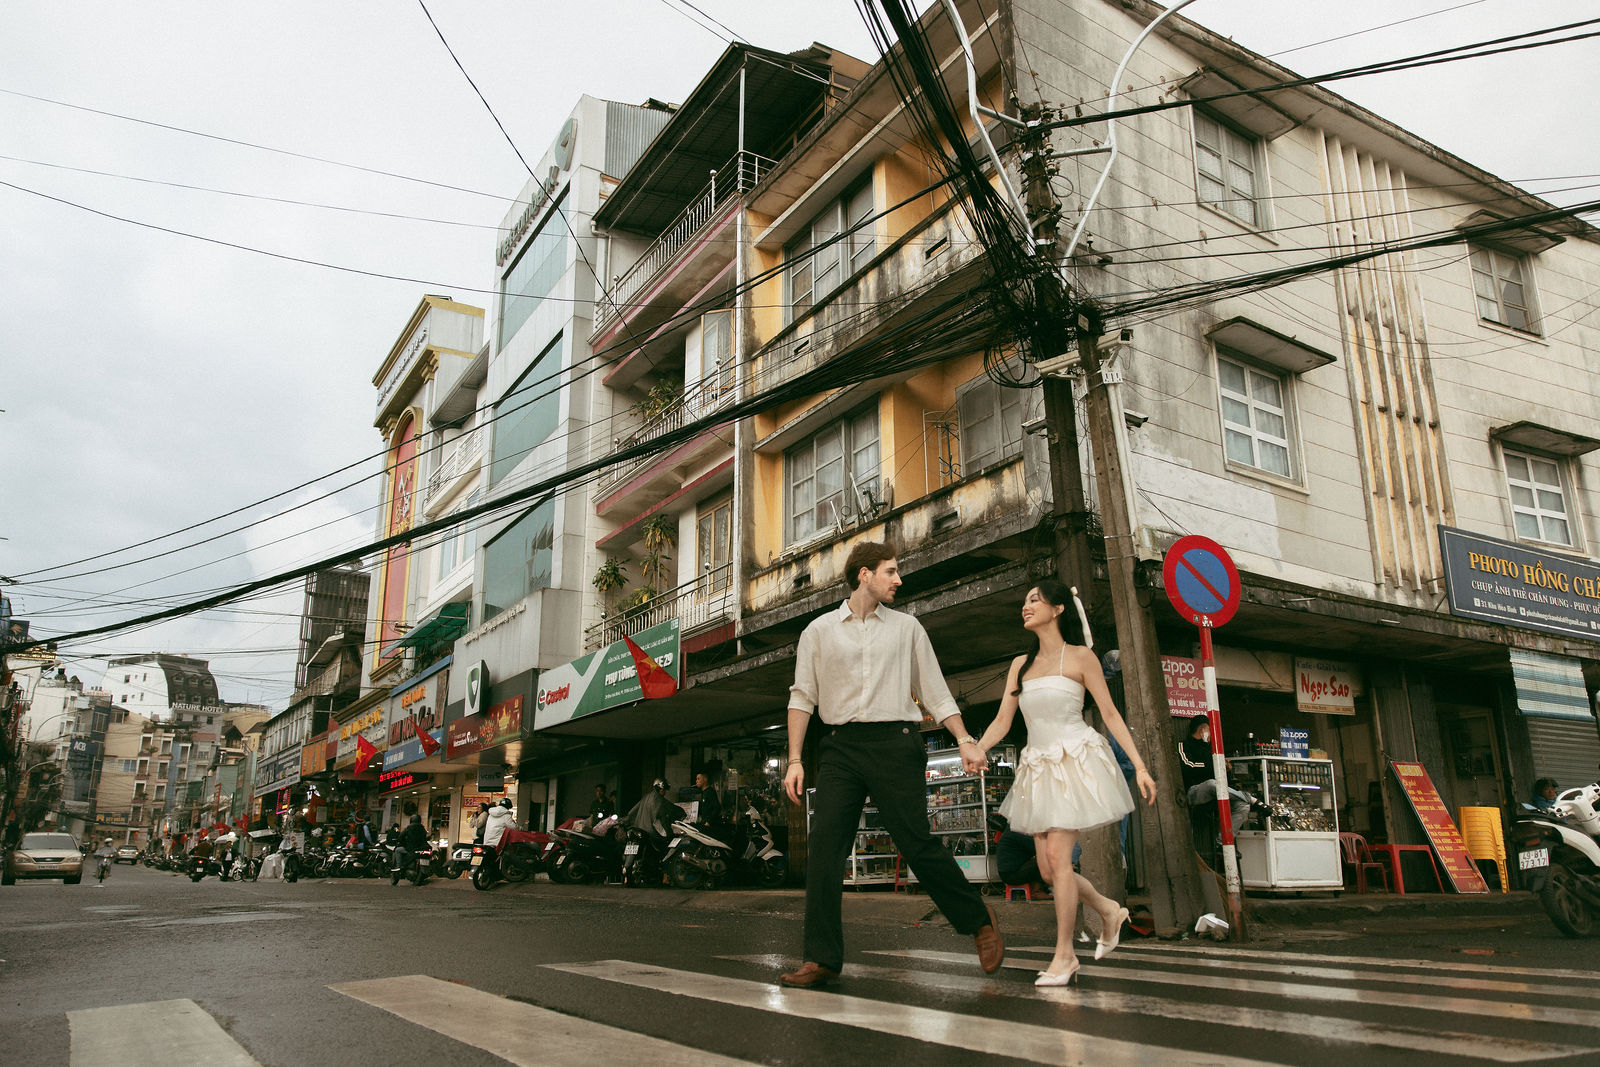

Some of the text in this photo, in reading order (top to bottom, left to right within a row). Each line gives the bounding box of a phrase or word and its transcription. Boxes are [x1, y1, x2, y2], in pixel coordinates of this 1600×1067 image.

[496, 165, 560, 267] Vietcombank
[1468, 551, 1519, 579] PHOTO
[1522, 560, 1570, 593] HỒNG
[1471, 580, 1493, 594] CHỤP
[1528, 591, 1549, 604] CHÂN
[1549, 596, 1569, 608] DUNG
[545, 683, 570, 705] Castrol
[1300, 672, 1350, 702] Ngọc Sao
[171, 702, 225, 714] NATURE HOTEL
[73, 741, 87, 752] ACB
